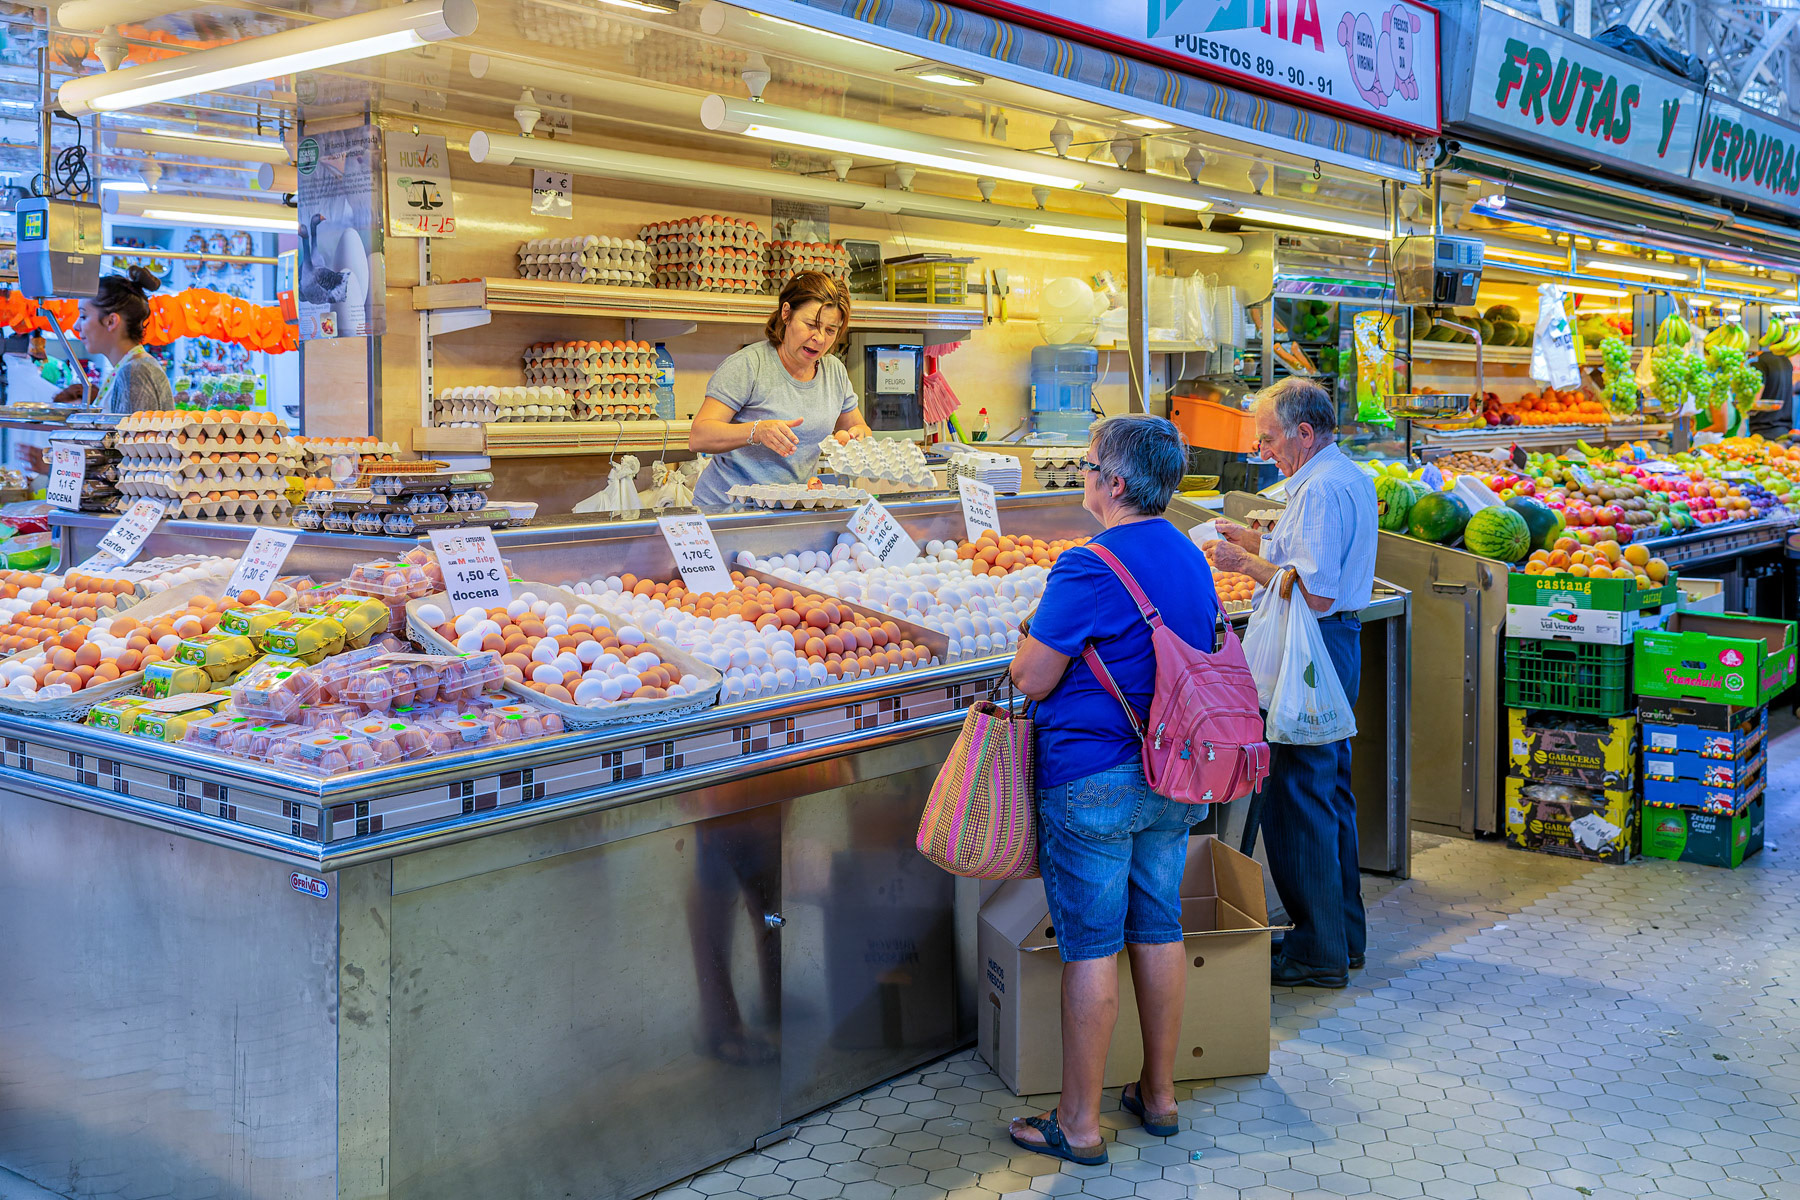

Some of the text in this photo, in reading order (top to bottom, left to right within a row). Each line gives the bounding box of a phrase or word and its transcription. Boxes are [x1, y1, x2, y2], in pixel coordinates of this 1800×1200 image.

[1357, 30, 1373, 49] HUEVOS
[1175, 34, 1252, 69] PUESTOS
[1256, 56, 1274, 77] 89
[1288, 66, 1304, 87] 90
[1317, 76, 1333, 96] 91
[1495, 37, 1680, 158] FRUTAS Y
[1699, 112, 1800, 196] VERDURAS
[560, 178, 567, 189] €
[69, 479, 76, 491] €
[48, 491, 72, 503] DOCENA
[970, 505, 983, 515] 2,10
[984, 509, 991, 519] €
[969, 516, 993, 529] docena
[874, 520, 893, 545] 2,10 €
[102, 537, 126, 555] carton
[472, 542, 485, 553] "A"
[878, 533, 900, 562] DOCENA
[457, 557, 466, 565] M
[242, 566, 268, 582] 1,30 €
[457, 568, 500, 583] 1,50 €
[681, 564, 716, 574] docena
[1536, 579, 1592, 595] castang
[452, 588, 499, 601] docena
[1642, 591, 1662, 605] castang
[1540, 621, 1553, 629] Val
[1554, 622, 1585, 632] Venosta
[1548, 752, 1601, 765] GABACERAS
[1690, 812, 1717, 824] Zespri
[1691, 821, 1716, 831] Green
[290, 873, 321, 893] COFRIVAL
[988, 956, 1004, 980] HUEVOS
[987, 969, 1005, 994] FRESCOS
